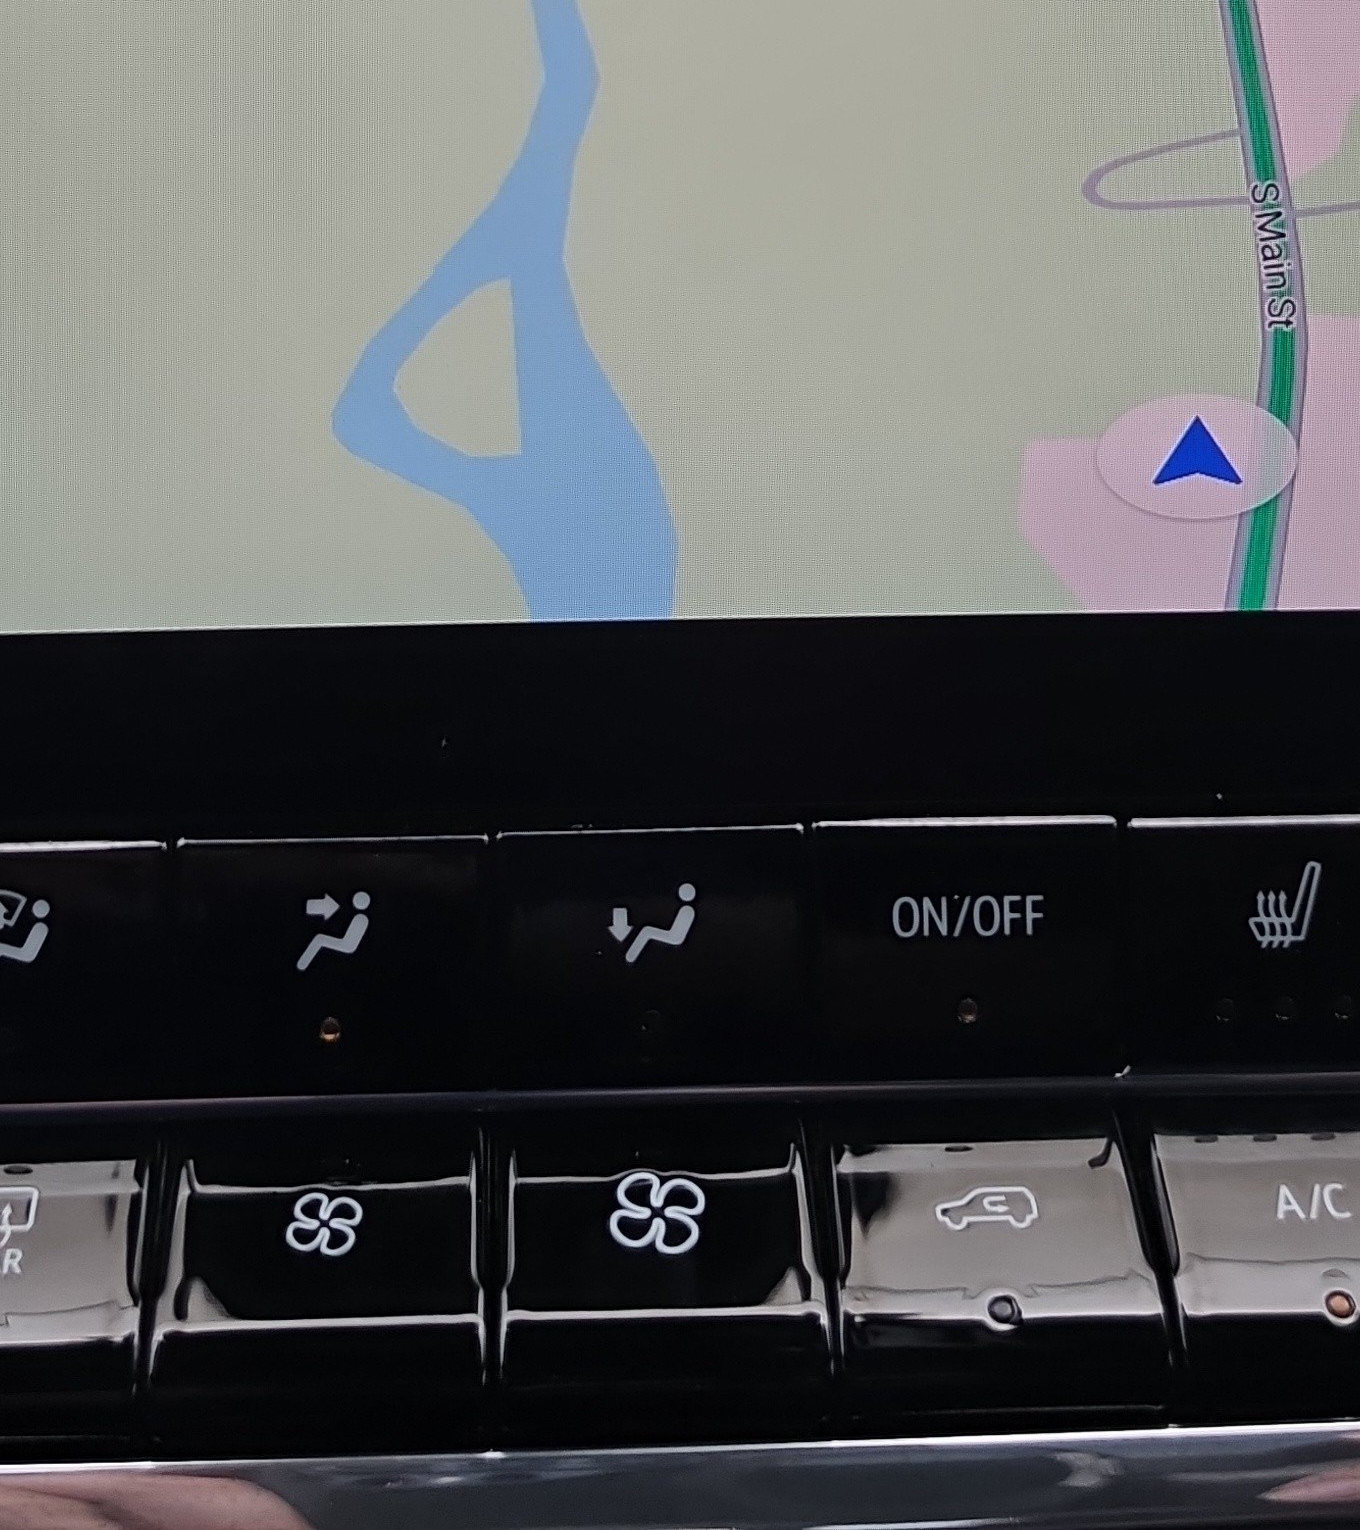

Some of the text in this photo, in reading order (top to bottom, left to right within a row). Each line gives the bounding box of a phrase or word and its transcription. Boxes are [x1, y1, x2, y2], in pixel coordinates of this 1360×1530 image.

[1251, 182, 1297, 329] S Main St
[891, 894, 1045, 938] ON/OFF
[1276, 1181, 1352, 1222] A/C
